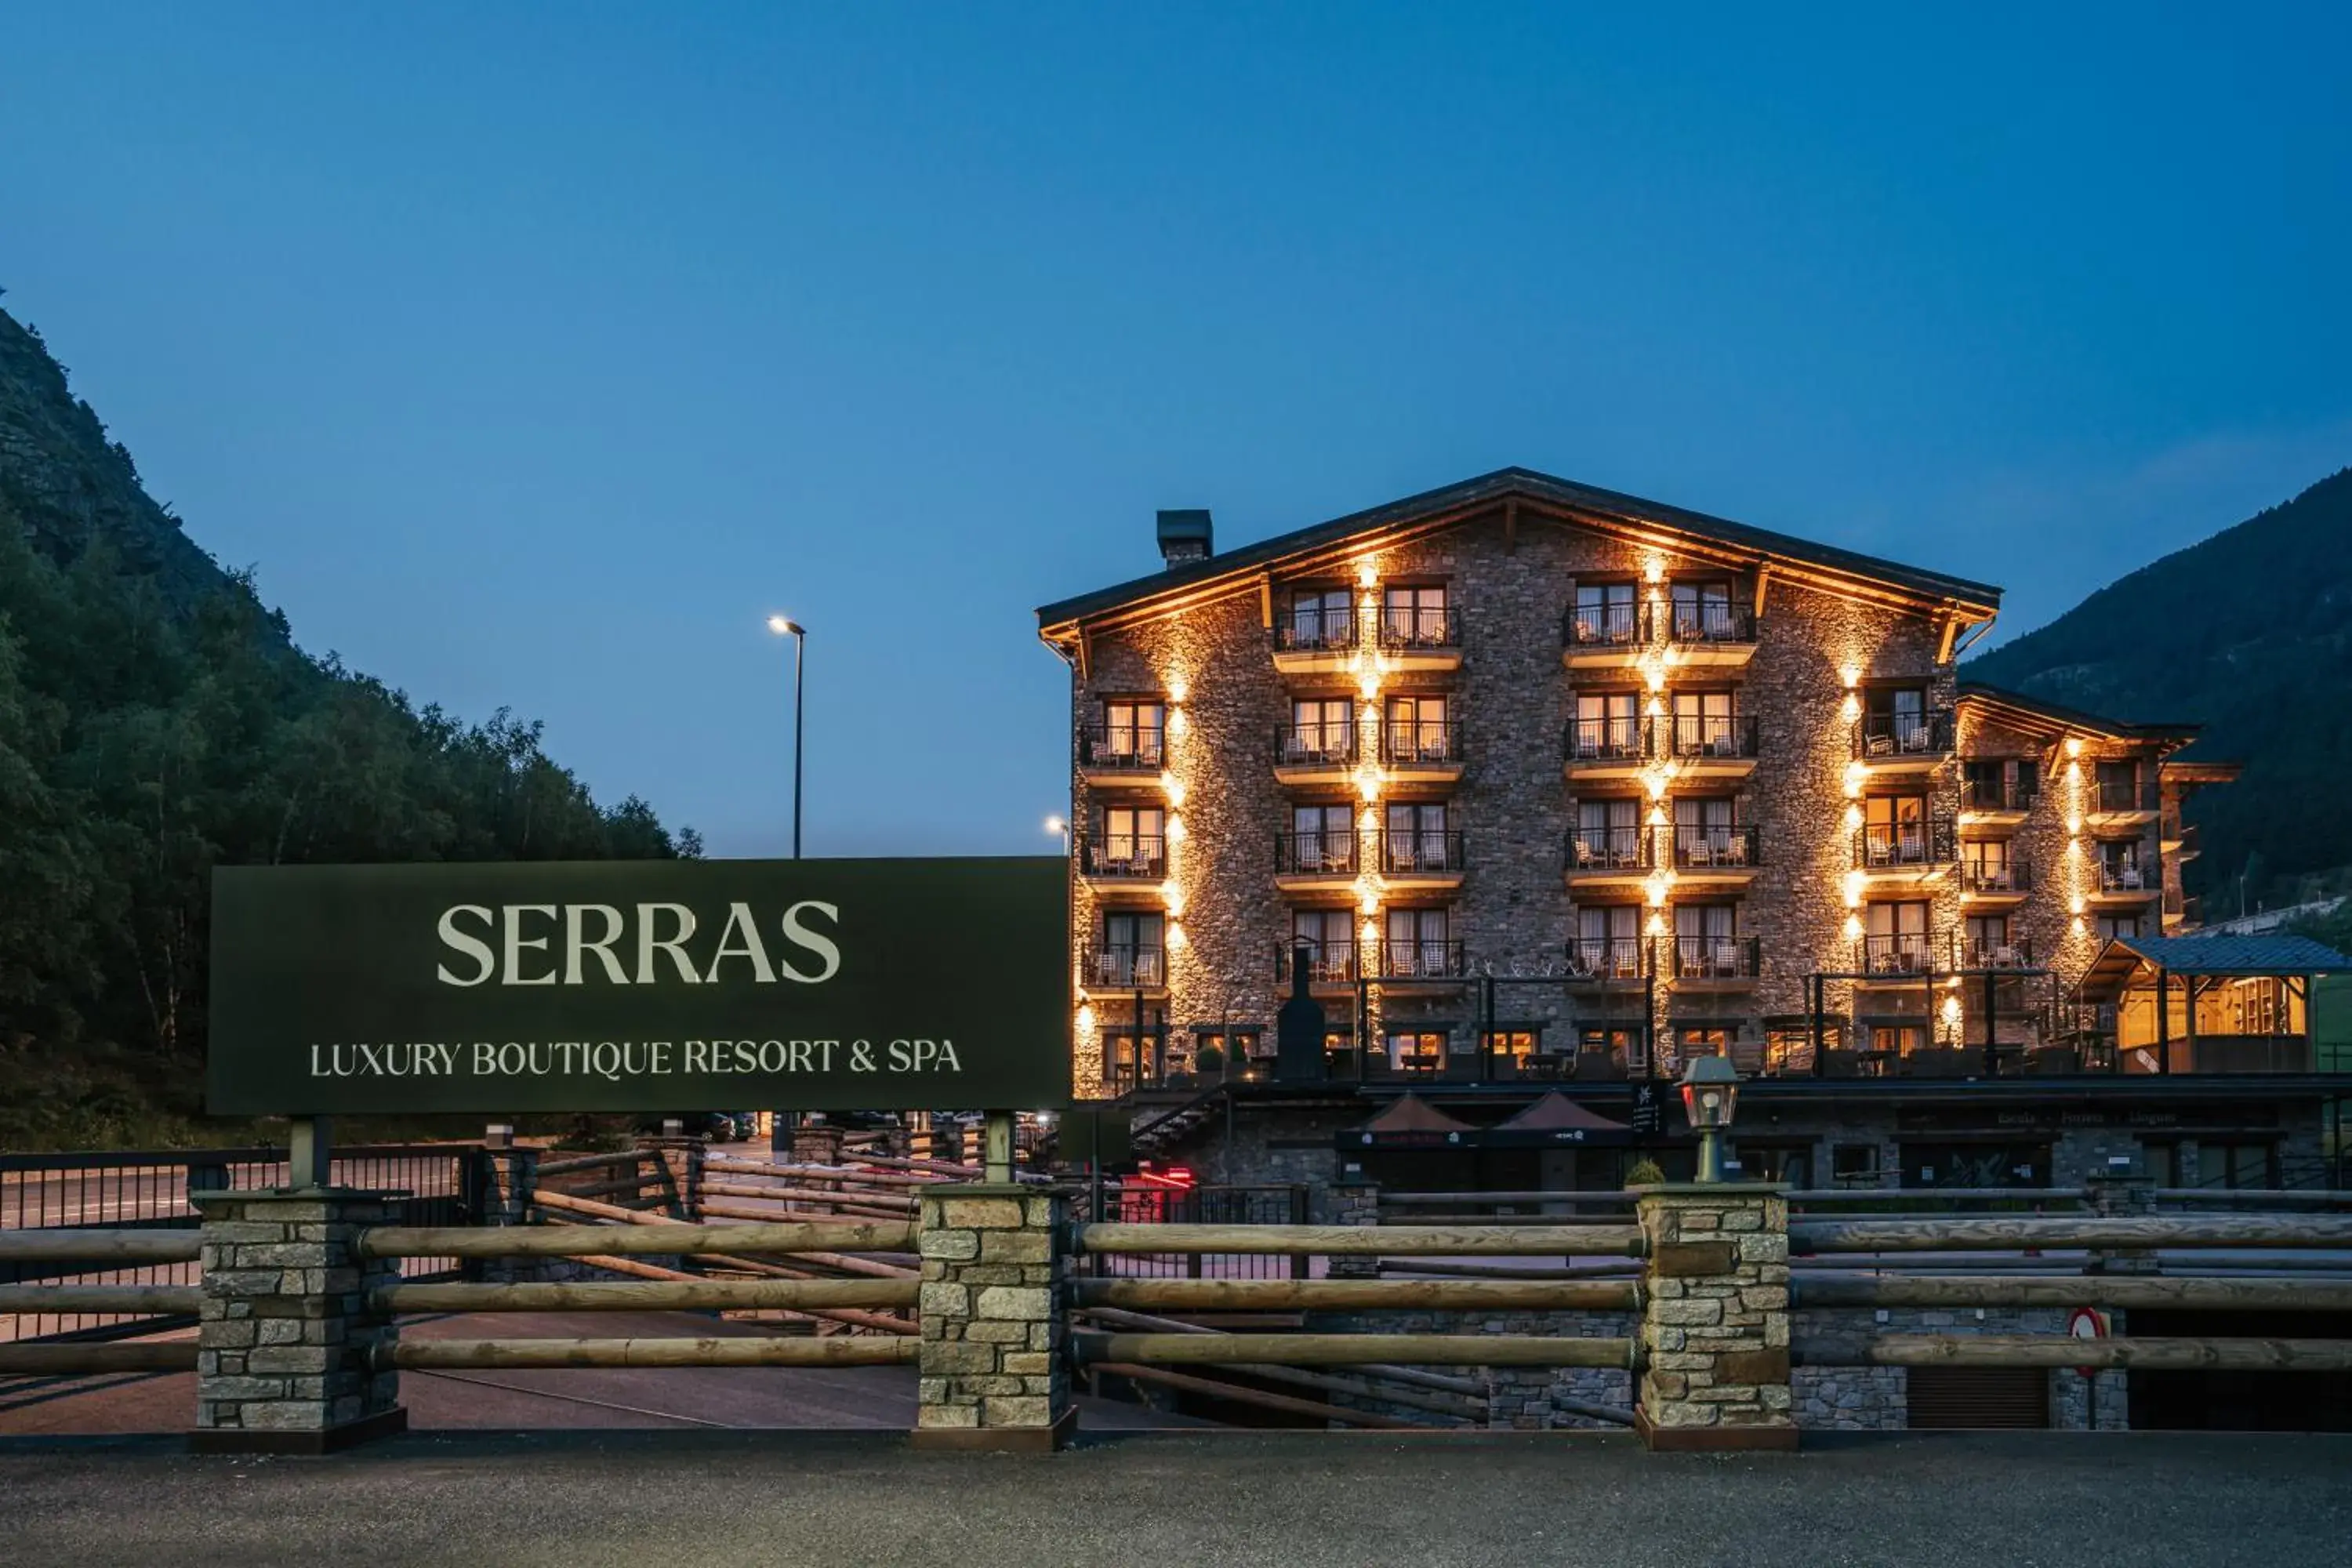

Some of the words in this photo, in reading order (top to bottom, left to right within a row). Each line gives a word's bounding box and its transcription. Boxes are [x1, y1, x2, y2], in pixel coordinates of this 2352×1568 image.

[437, 901, 841, 987] SERRAS
[310, 1043, 461, 1077] LUXURY
[473, 1042, 672, 1081] BOUTIQUE
[684, 1040, 840, 1073] RESORT
[850, 1040, 877, 1072] &
[888, 1039, 961, 1072] SPA
